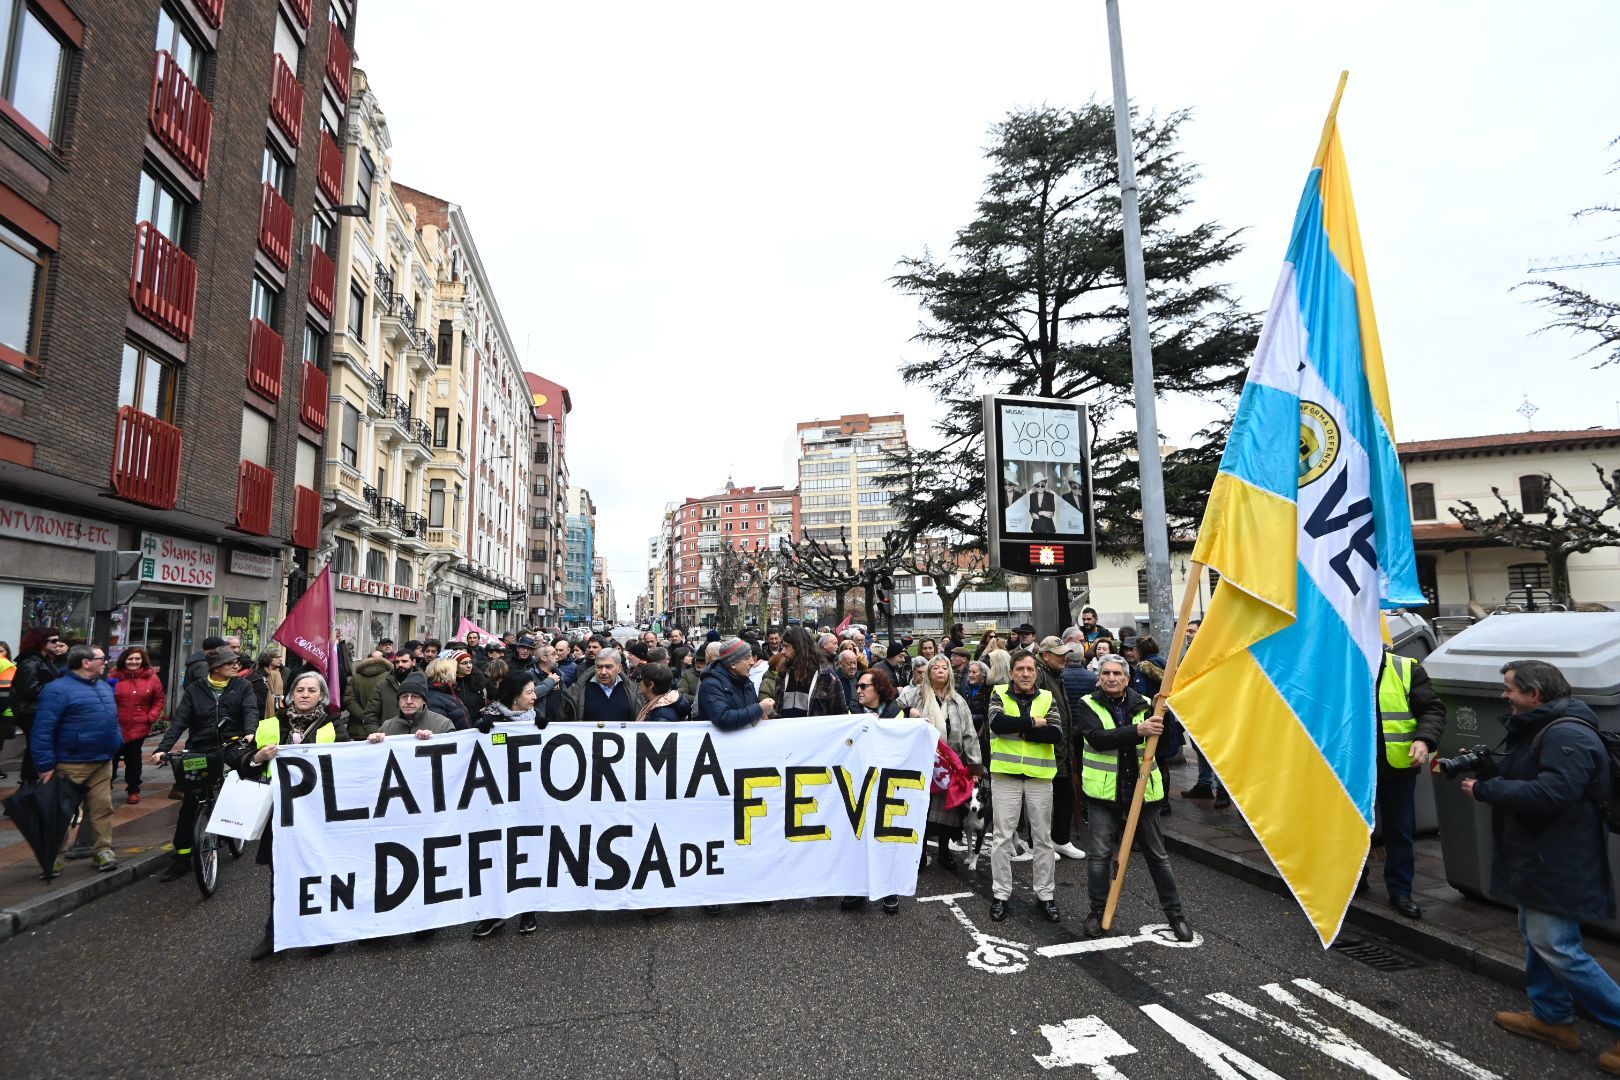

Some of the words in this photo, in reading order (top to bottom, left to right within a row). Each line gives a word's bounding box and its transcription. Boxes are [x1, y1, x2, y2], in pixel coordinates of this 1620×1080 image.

[1012, 411, 1069, 443] yoko
[1019, 438, 1066, 457] ono
[1317, 429, 1335, 469] DEFENSA
[161, 564, 212, 585] BOLSOS
[276, 731, 731, 828] PLATAFORMA
[299, 872, 356, 916] EN
[374, 822, 676, 914] DEFENSA
[680, 841, 725, 878] DE
[734, 765, 926, 846] FEVE
